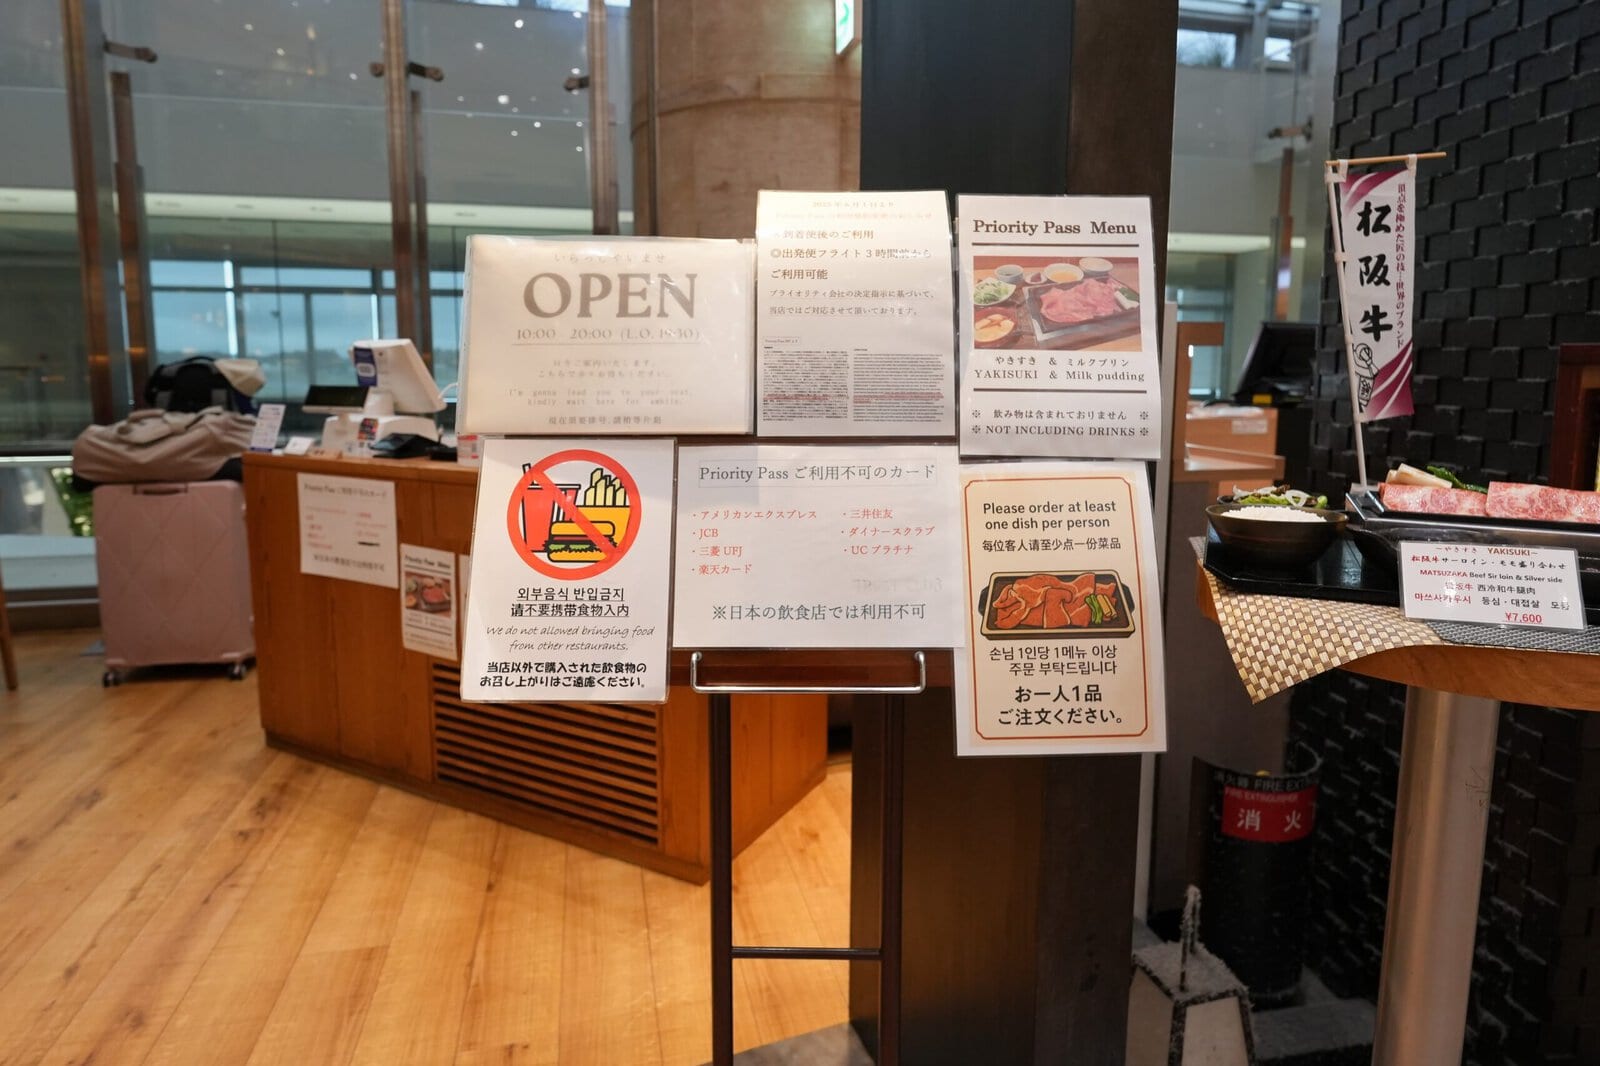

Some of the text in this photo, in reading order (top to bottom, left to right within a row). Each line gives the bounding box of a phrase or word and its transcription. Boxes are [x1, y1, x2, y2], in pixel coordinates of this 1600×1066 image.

[973, 219, 1137, 236] Priority Pass Menu
[771, 269, 828, 280] ご利用可能
[1356, 201, 1393, 342] 松阪牛
[523, 272, 697, 318] OPEN
[517, 328, 556, 340] 10:00
[570, 328, 612, 340] 20:00
[995, 356, 1129, 367] やきすき & ミルクプリン
[974, 369, 1144, 382] YAKISUKI & Milk pudding
[993, 409, 1127, 420] 飲み物は含まれておりません
[986, 425, 1011, 435] NOT
[1015, 426, 1084, 436] INCLUDING
[1088, 427, 1135, 437] DRINKS
[699, 464, 935, 483] Priority Pass ご利用不可のカード
[983, 500, 1117, 514] Please order at least
[985, 517, 1110, 532] one dish per person
[724, 546, 743, 558] UFJ
[872, 545, 913, 555] プラチナ
[1420, 569, 1468, 578] MATSUZAKA
[1469, 571, 1486, 579] Beef
[1499, 573, 1514, 581] loin
[1524, 574, 1545, 583] Silver
[1547, 576, 1563, 584] side
[517, 588, 625, 600] 외부음식 반입금지
[511, 603, 630, 617] 请不要携带食物入内
[1505, 612, 1542, 624] ¥7,600
[486, 625, 655, 638] We do not allowed bringing food
[509, 640, 629, 652] from other restaurants.
[989, 645, 1117, 660] 손님 1인당 1메뉴 이상
[487, 661, 647, 674] 当店以外で購入された飲食物の
[1009, 661, 1117, 676] 주문 부탁드립니다
[480, 676, 645, 688] お召し上がりはご遠慮ください。
[1015, 685, 1102, 702] お一人1品
[998, 708, 1123, 725] ご注文ください。
